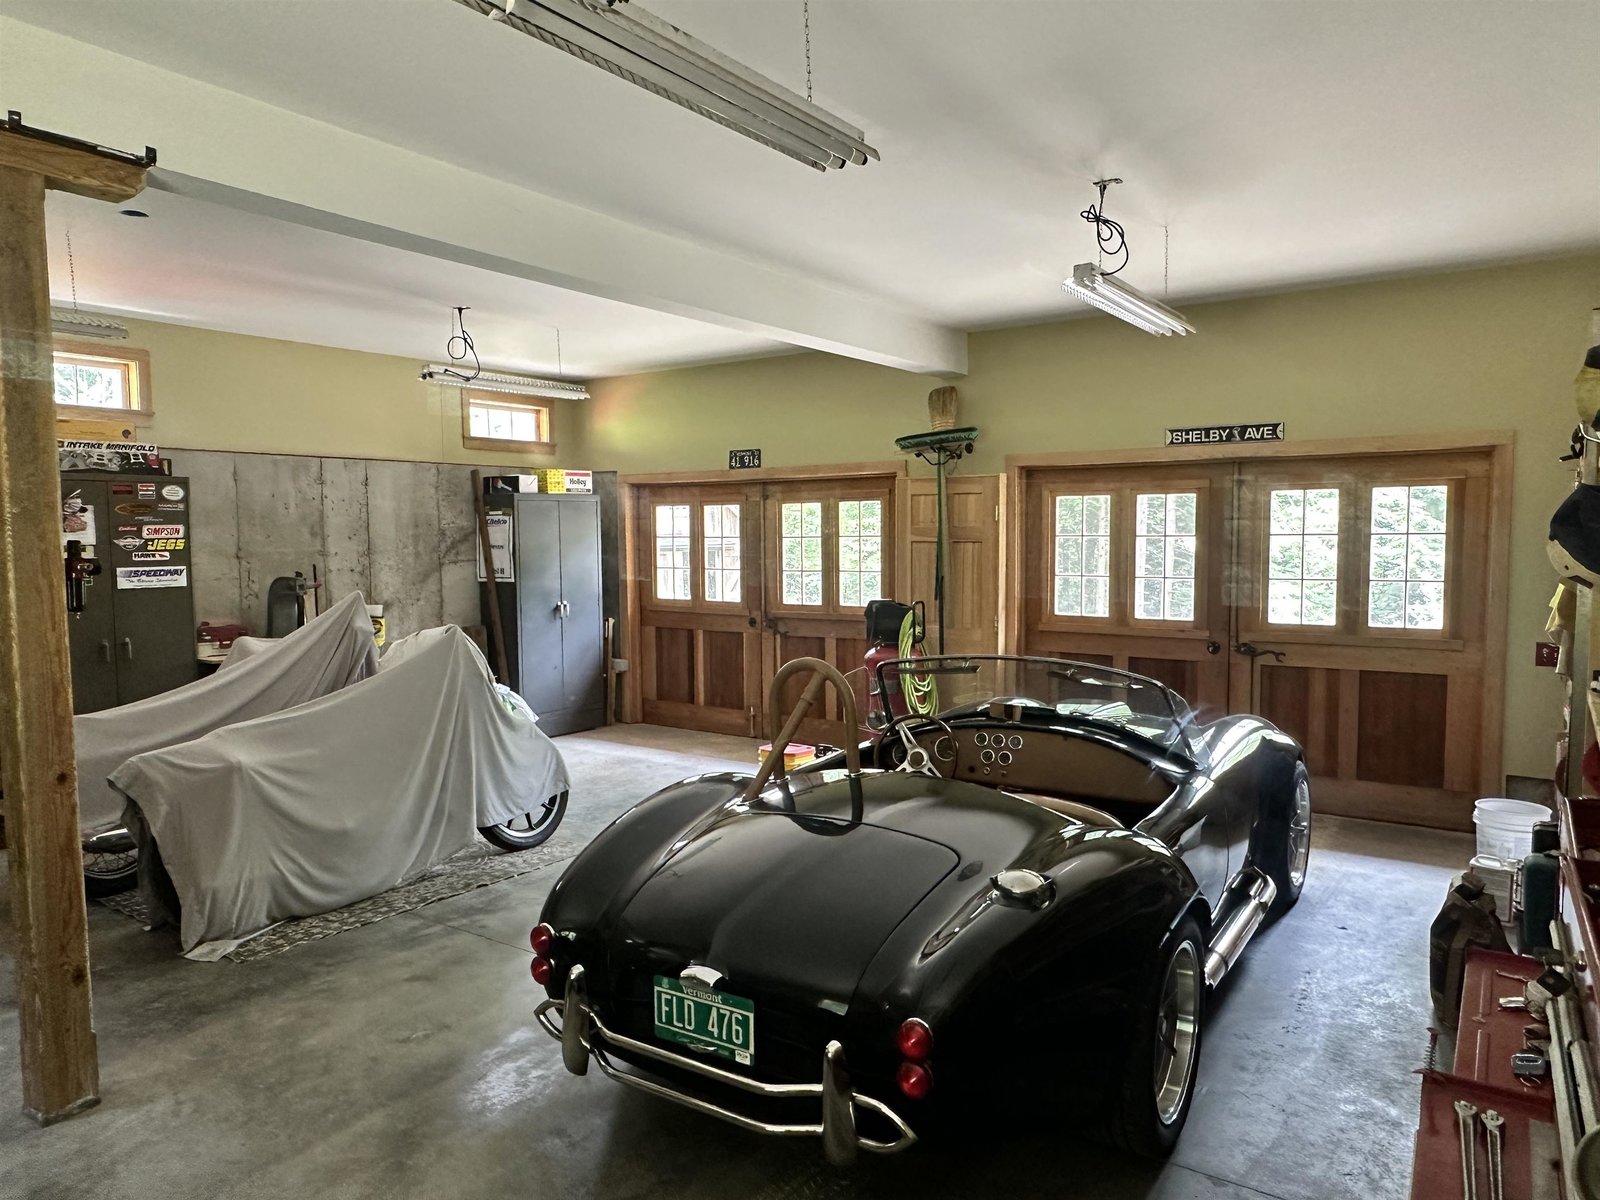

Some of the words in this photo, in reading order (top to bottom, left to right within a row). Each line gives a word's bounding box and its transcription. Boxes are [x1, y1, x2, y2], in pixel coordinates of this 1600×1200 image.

[1172, 429, 1229, 443] SHELBY
[1244, 427, 1276, 439] AVE.
[66, 441, 103, 449] INTAKE
[106, 443, 155, 452] MANIFOLD
[569, 478, 587, 487] Holley
[146, 527, 180, 536] SIMPSON
[147, 539, 186, 550] JEGS
[131, 568, 185, 578] SPEEDWAY
[682, 985, 722, 1004] Vermont
[661, 993, 695, 1031] FLD
[707, 1006, 743, 1045] 476
